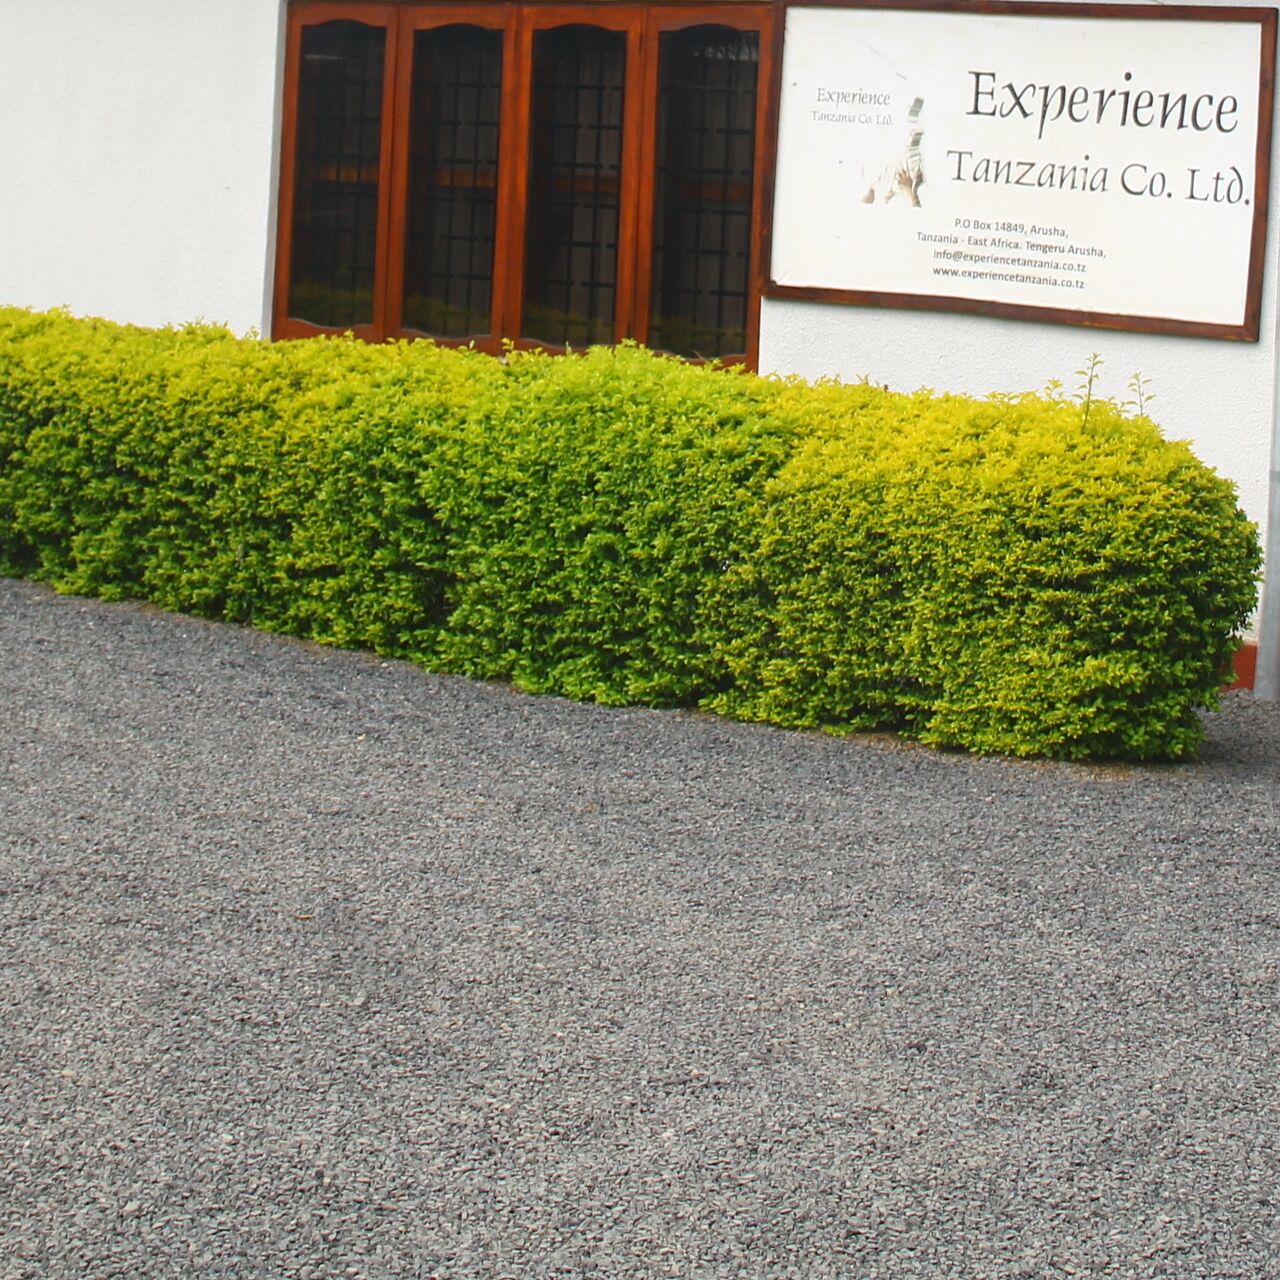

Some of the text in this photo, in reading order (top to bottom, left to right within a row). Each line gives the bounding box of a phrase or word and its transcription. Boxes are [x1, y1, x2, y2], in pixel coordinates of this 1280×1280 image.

[817, 87, 890, 108] Experience
[966, 70, 1239, 140] Experience
[811, 110, 856, 124] Tanzania
[858, 113, 873, 125] Co.
[946, 150, 1250, 206] Tanzania Co. Ltd.
[954, 218, 1069, 238] P.O Box 14849, Arusha,
[916, 231, 958, 244] Tanzania
[967, 235, 987, 247] East
[1025, 240, 1065, 254] Tengeru
[1067, 244, 1106, 259] Arusha,
[933, 249, 1086, 272] info@experiencetanzania.co.tz
[933, 267, 1085, 289] www.experiencetanzania.co.tz
